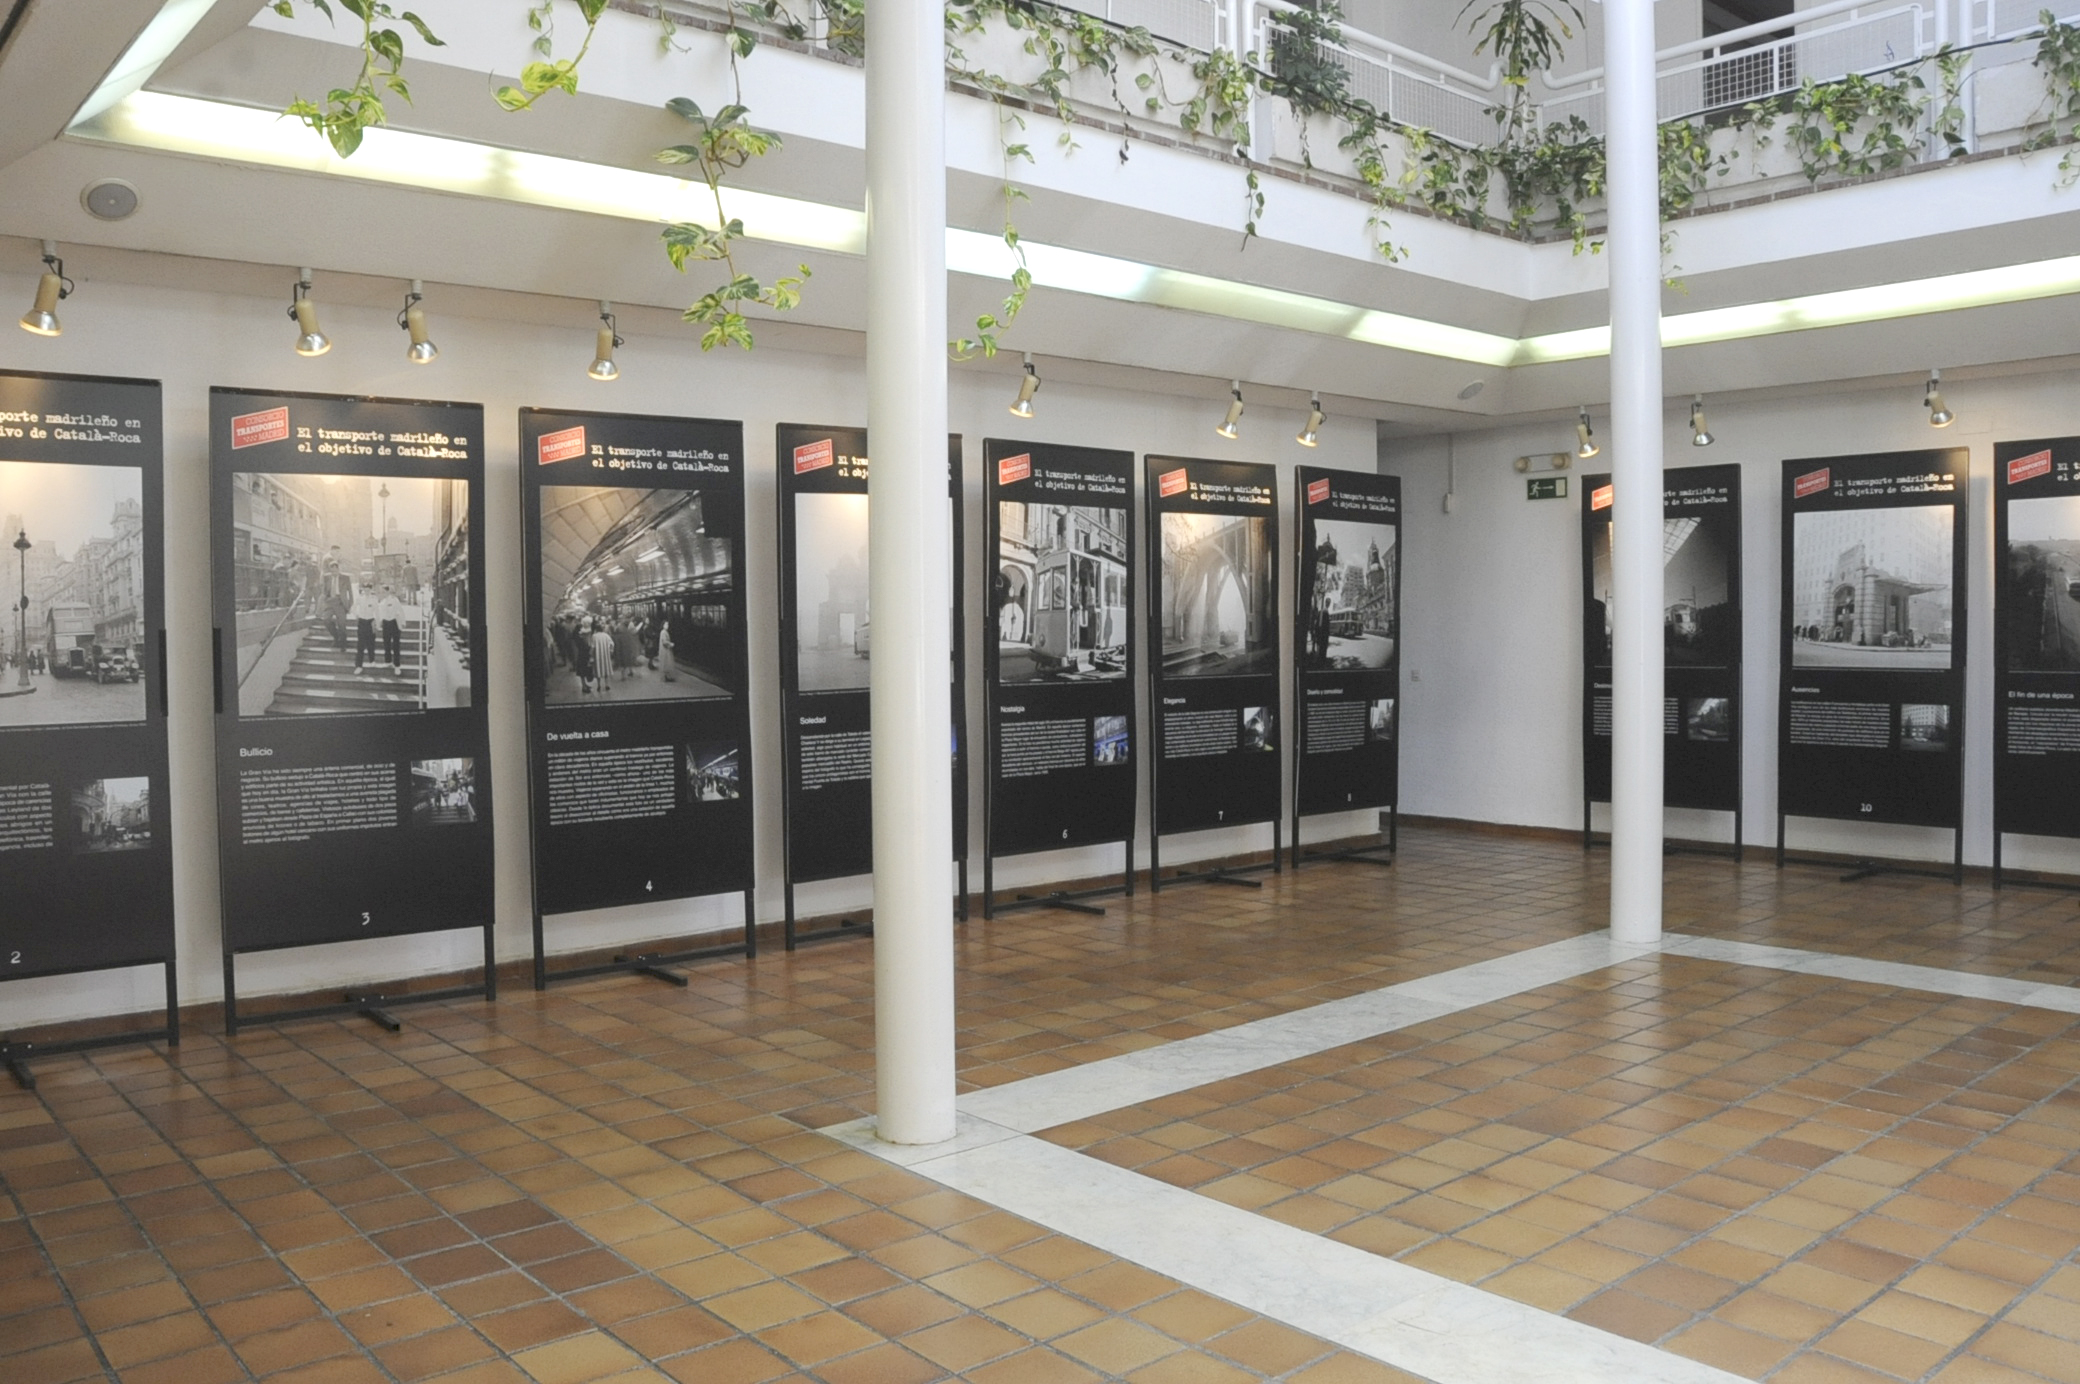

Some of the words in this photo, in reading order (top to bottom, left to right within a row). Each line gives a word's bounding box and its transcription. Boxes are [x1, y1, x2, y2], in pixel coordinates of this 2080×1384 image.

[45, 413, 118, 427] madrileño
[125, 419, 141, 428] en
[30, 427, 47, 439] de
[236, 419, 285, 437] TRANSPORTES
[296, 427, 313, 439] El
[317, 427, 385, 443] transporte
[389, 432, 449, 446] madrileño
[453, 436, 468, 446] en
[297, 441, 313, 453] el
[318, 442, 373, 456] objetivo
[377, 444, 392, 456] de
[591, 444, 604, 455] El
[607, 445, 663, 459] transporte
[666, 448, 714, 460] madrileño
[717, 453, 729, 461] en
[592, 457, 604, 468] el
[608, 457, 653, 471] objetivo
[656, 460, 668, 470] de
[837, 455, 848, 465] El
[838, 467, 849, 477] el
[2057, 462, 2069, 471] El
[1034, 469, 1042, 477] El
[1045, 470, 1081, 481] transporte
[2057, 473, 2069, 481] el
[1034, 480, 1042, 488] el
[1045, 481, 1076, 491] objetivo
[1077, 483, 1085, 491] de
[1847, 477, 1893, 487] transporte
[1847, 487, 1884, 497] objetivo
[1886, 486, 1897, 494] de
[547, 732, 558, 741] De
[560, 731, 583, 740] vuelta
[591, 730, 609, 738] casa
[239, 747, 273, 758] Bullicio
[1860, 802, 1873, 812] 10
[1062, 828, 1068, 839] 6
[645, 879, 653, 892] 4
[361, 911, 370, 926] 3
[10, 951, 21, 964] 2
